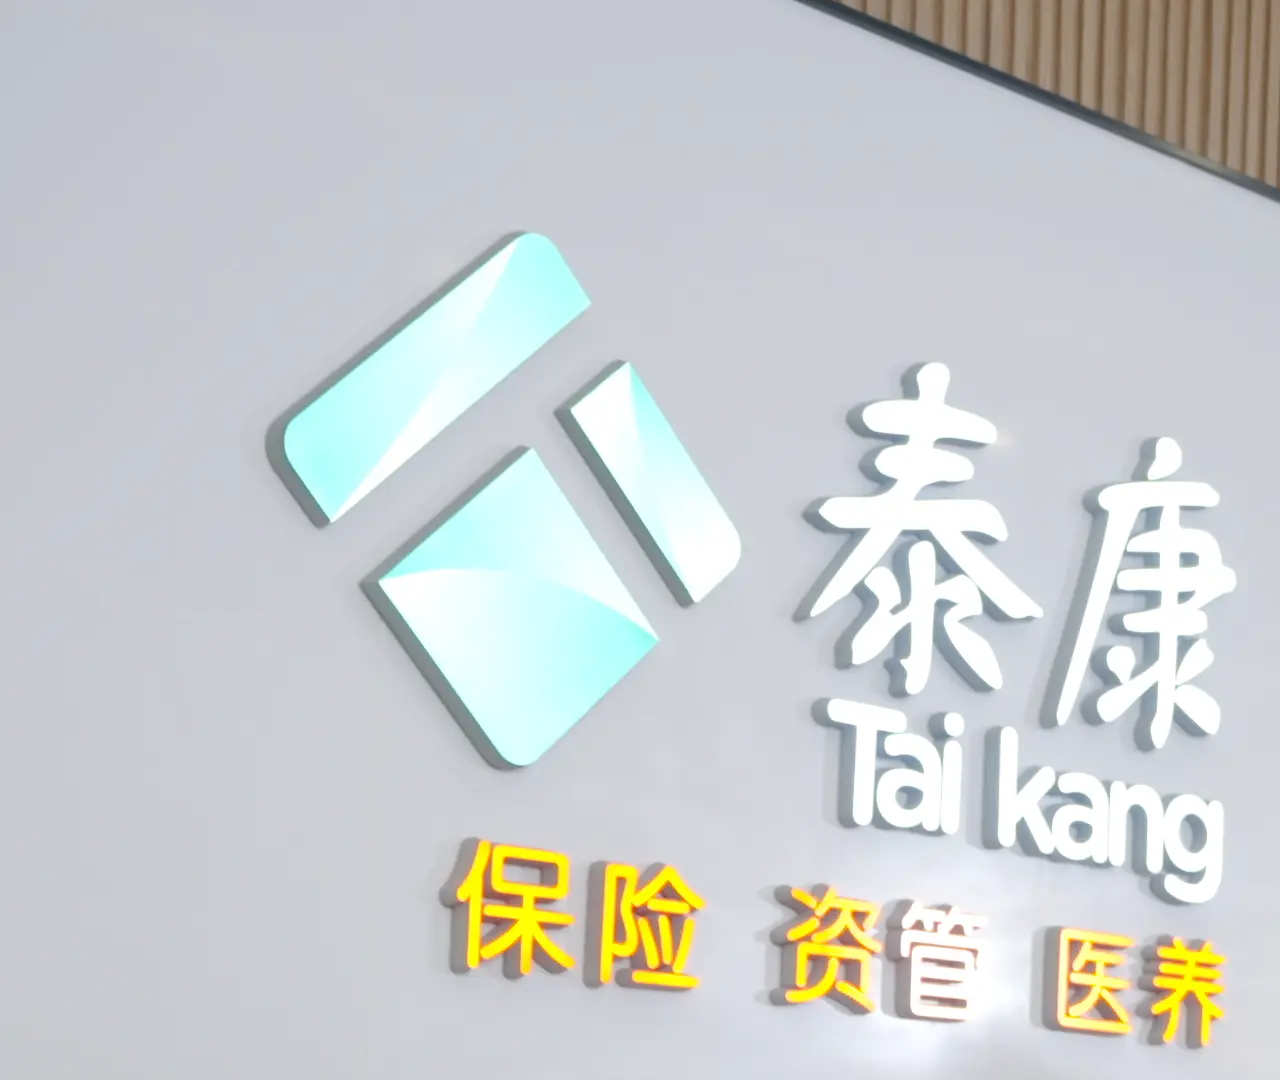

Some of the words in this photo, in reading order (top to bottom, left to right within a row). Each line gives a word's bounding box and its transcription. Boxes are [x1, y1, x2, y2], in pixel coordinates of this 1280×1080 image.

[809, 361, 1237, 748] 泰康
[455, 839, 708, 990] 保险
[785, 887, 989, 1021] 资管
[1057, 927, 1228, 1047] 医养
